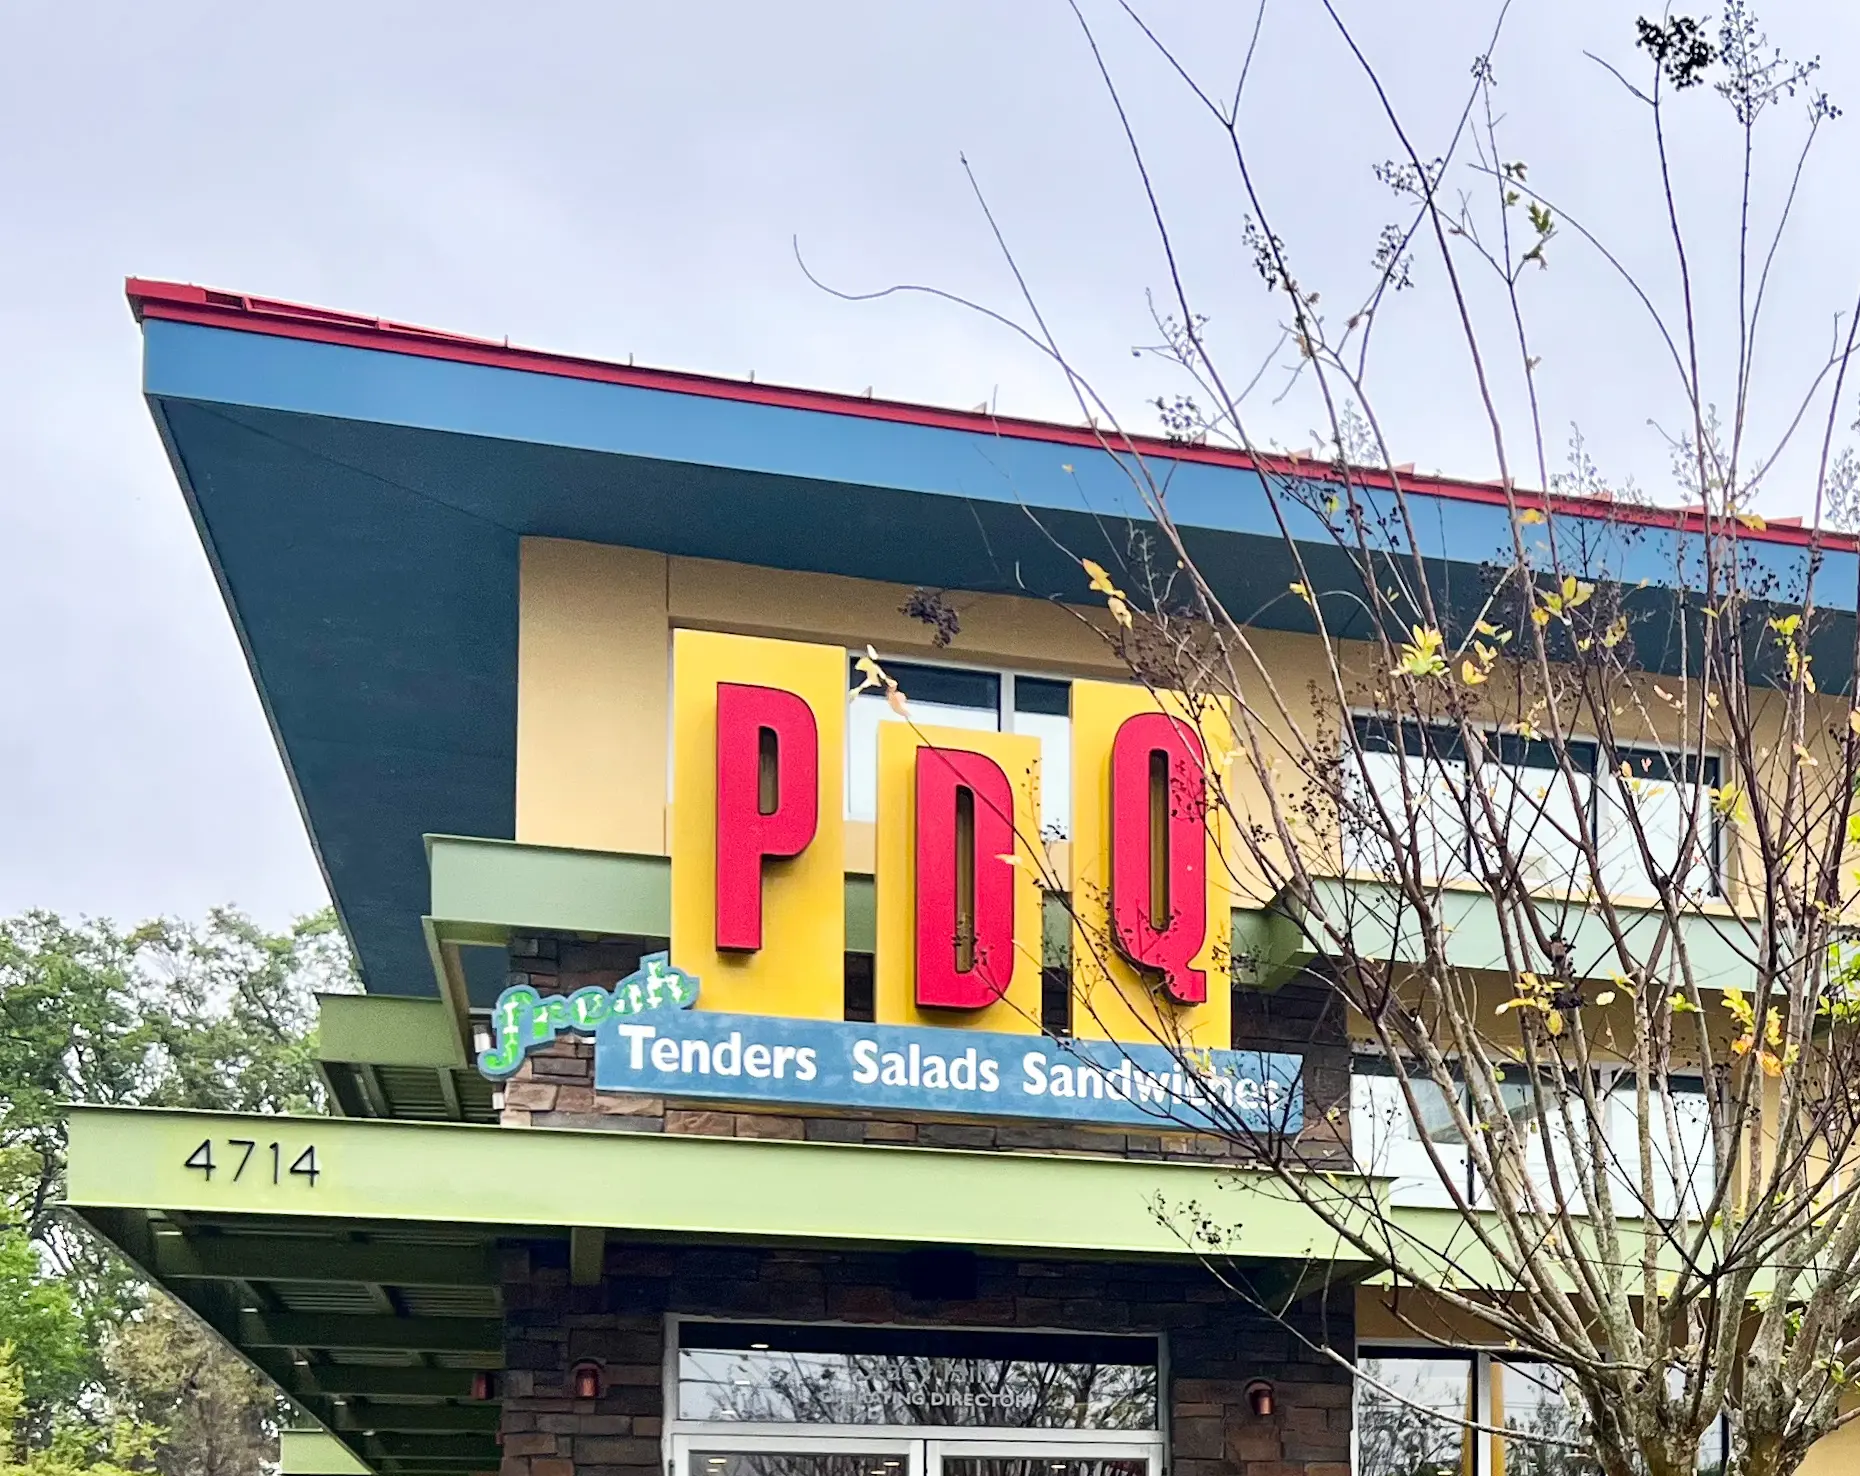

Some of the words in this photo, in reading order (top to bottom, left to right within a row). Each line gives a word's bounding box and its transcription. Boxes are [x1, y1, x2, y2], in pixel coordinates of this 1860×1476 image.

[716, 680, 1208, 1010] PDQ
[483, 959, 694, 1068] fresh
[618, 1024, 818, 1082] Tenders
[852, 1039, 1000, 1093] Salads
[1022, 1051, 1280, 1112] Sandwiches
[184, 1138, 321, 1188] 4714
[931, 1391, 1034, 1409] DIRECTOR
